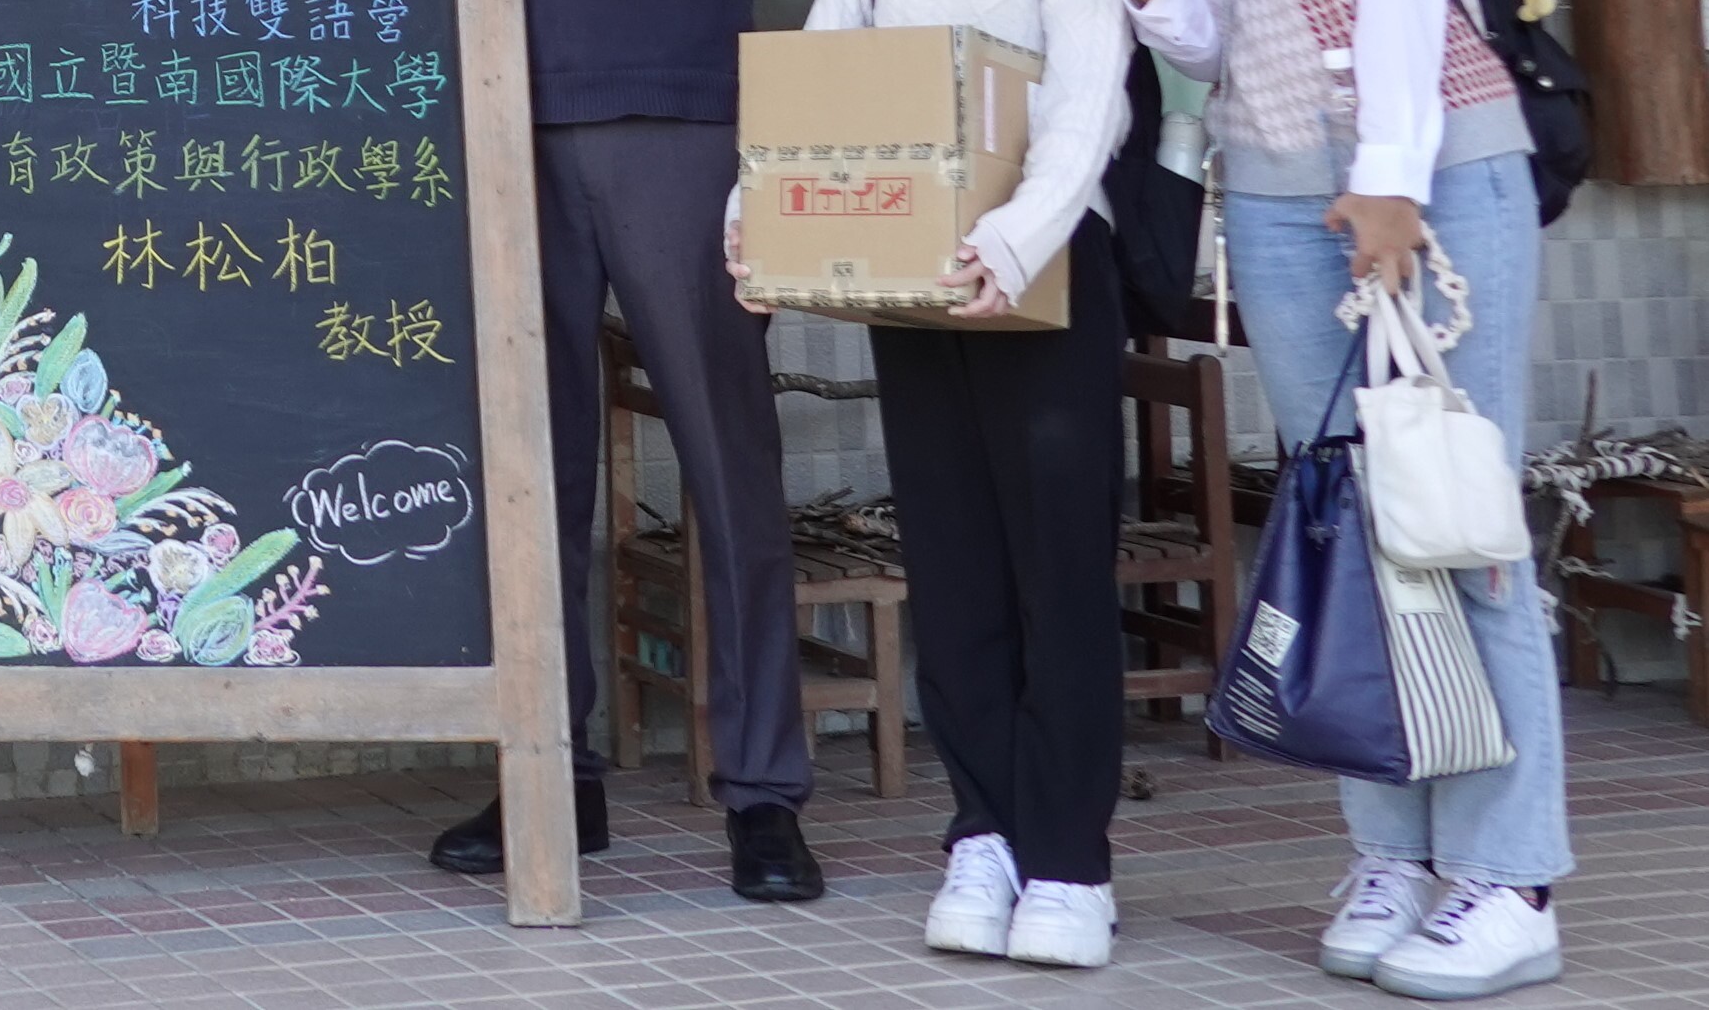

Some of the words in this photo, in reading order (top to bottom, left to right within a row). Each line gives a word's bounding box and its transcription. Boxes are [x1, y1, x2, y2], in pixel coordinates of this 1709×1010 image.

[102, 219, 336, 291] 林松柏
[314, 299, 456, 365] 教授
[308, 471, 457, 528] Welcome
